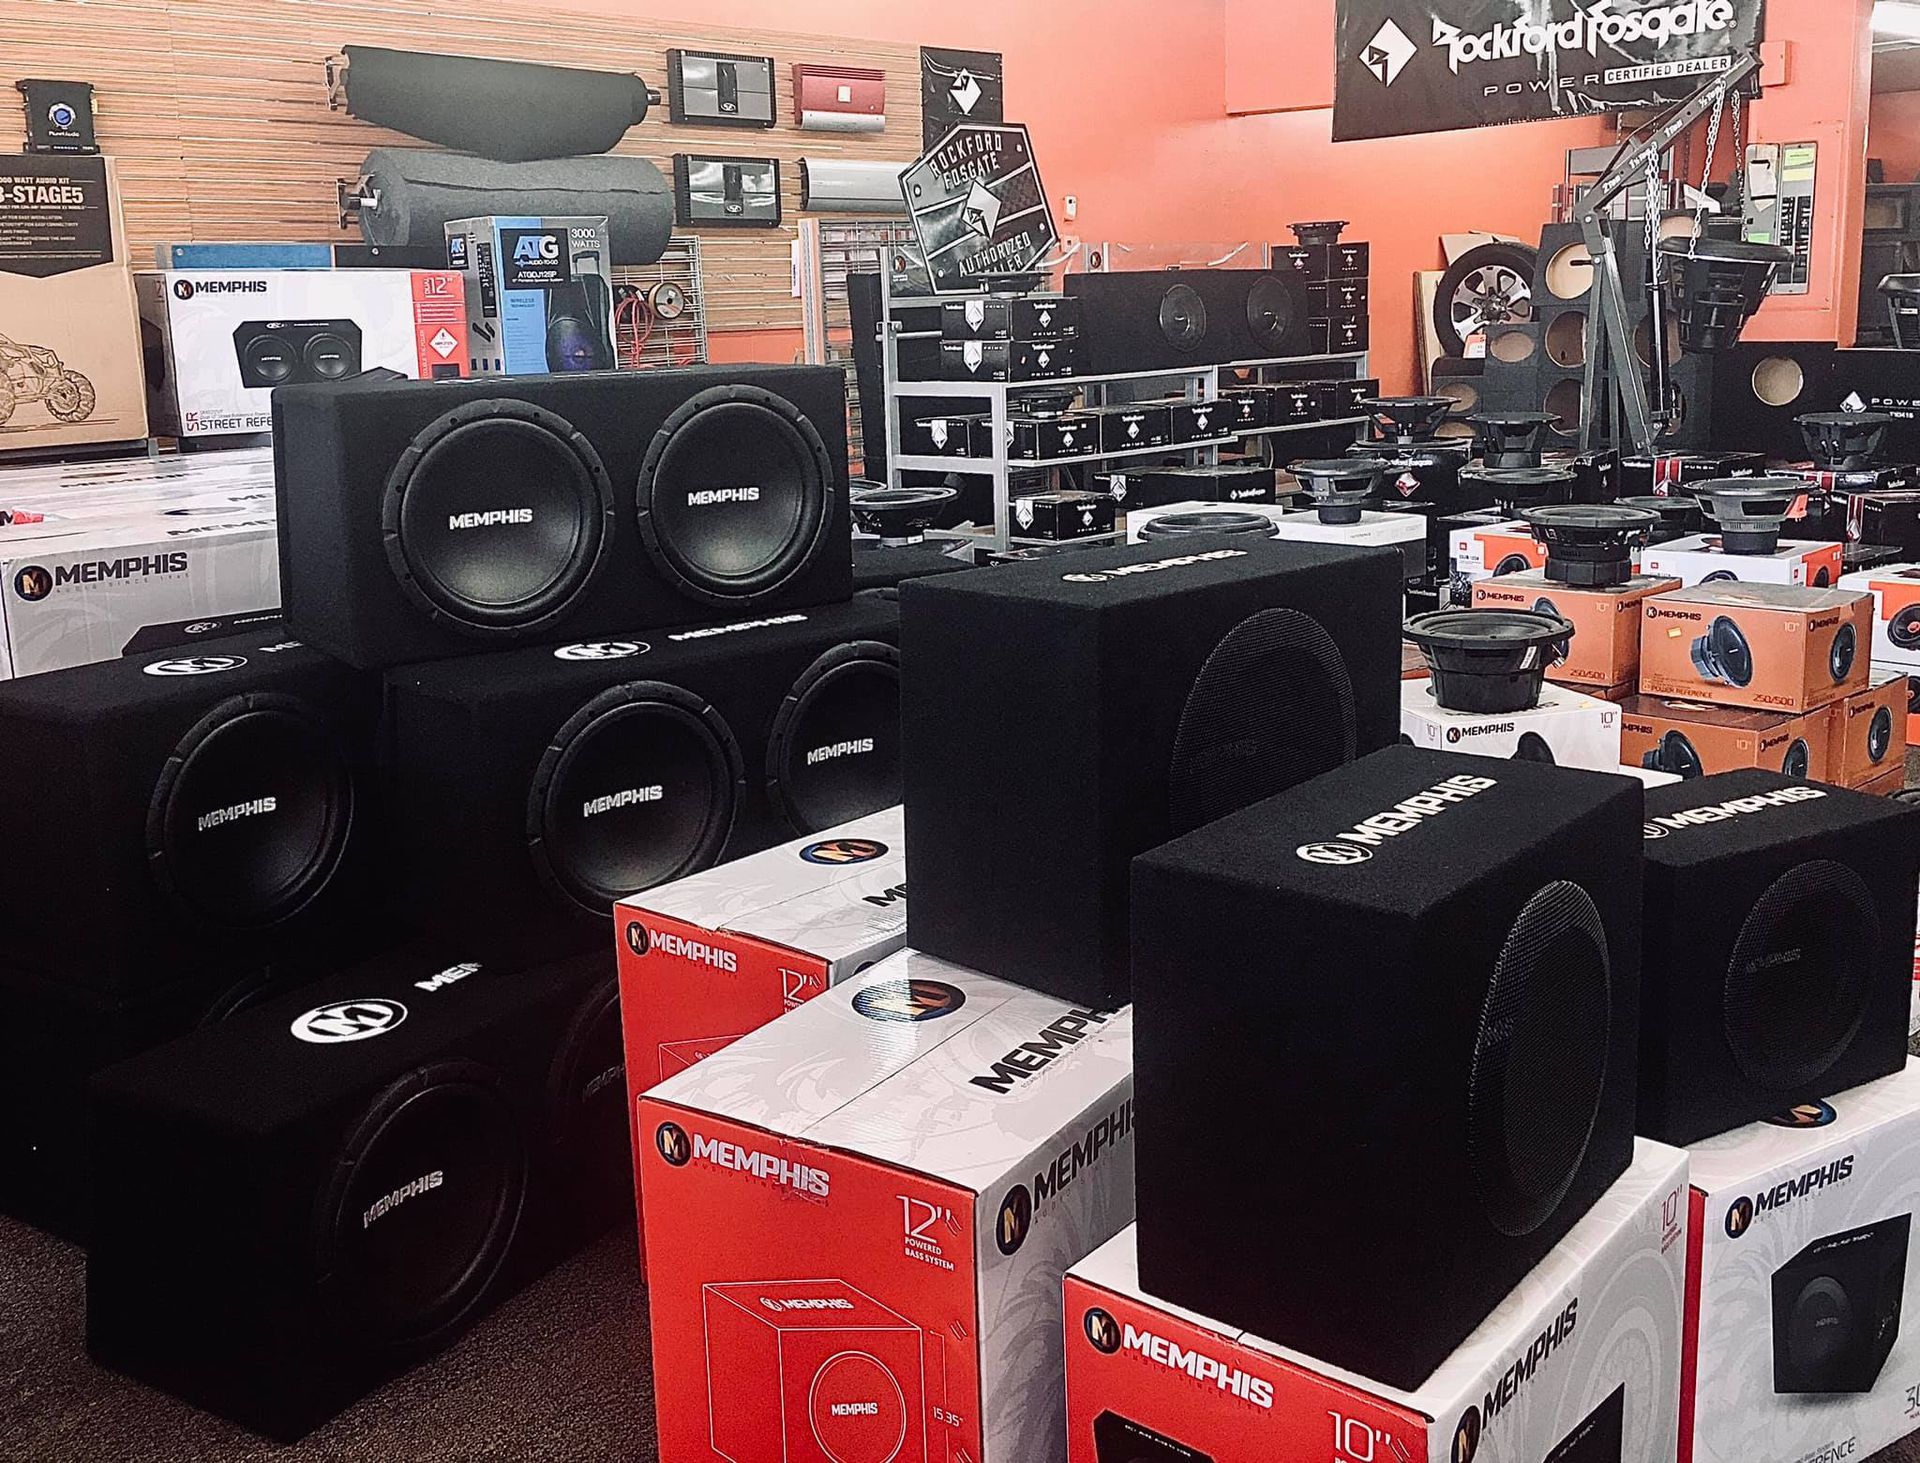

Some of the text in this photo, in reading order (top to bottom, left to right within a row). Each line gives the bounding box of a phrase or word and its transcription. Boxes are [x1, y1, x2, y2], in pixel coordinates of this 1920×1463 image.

[1431, 10, 1583, 74] Rockford
[1483, 57, 1728, 97] POWER CERTIFIED DEALER
[929, 132, 1002, 179] ROCKFORD
[943, 151, 1000, 190] FOSGATE
[513, 235, 559, 259] ATG
[571, 228, 596, 239] 3000
[571, 239, 601, 249] WATTS
[958, 231, 1031, 277] AUTHORIZED
[195, 280, 267, 294] MEMPHIS
[1871, 397, 1920, 406] POWE
[200, 416, 273, 431] STREET REFE
[687, 487, 760, 507] MEMPHIS
[449, 508, 533, 531] MEMPHIS
[55, 552, 188, 586] MEMPHIS
[1487, 593, 1525, 603] MEMPHIS
[1658, 610, 1702, 621] MEMPHIS
[1569, 669, 1606, 680] 250/500
[1753, 693, 1794, 707] 250/500
[1461, 722, 1515, 738] MEMPHIS
[807, 738, 874, 766] MEMPHIS
[198, 796, 277, 832] MEMPHIS
[583, 784, 663, 818] MEMPHIS
[1335, 774, 1499, 846] MEMPHIS
[1651, 785, 1828, 830] MEMPHIS
[650, 929, 738, 974] MEMPHIS
[692, 1133, 830, 1198] MEMPHIS
[1034, 1098, 1135, 1213] MEMPHI
[363, 1169, 444, 1230] MEMPHIS
[1754, 1154, 1855, 1217] MEMPHIS
[904, 1236, 943, 1256] POWERED
[904, 1247, 955, 1272] BASS SYSTEM
[784, 1297, 854, 1310] MEMPHIS
[1122, 1322, 1275, 1410] MEMPHIS
[1481, 1296, 1579, 1431] MEMPHIS
[831, 1402, 878, 1417] MEMPHIS
